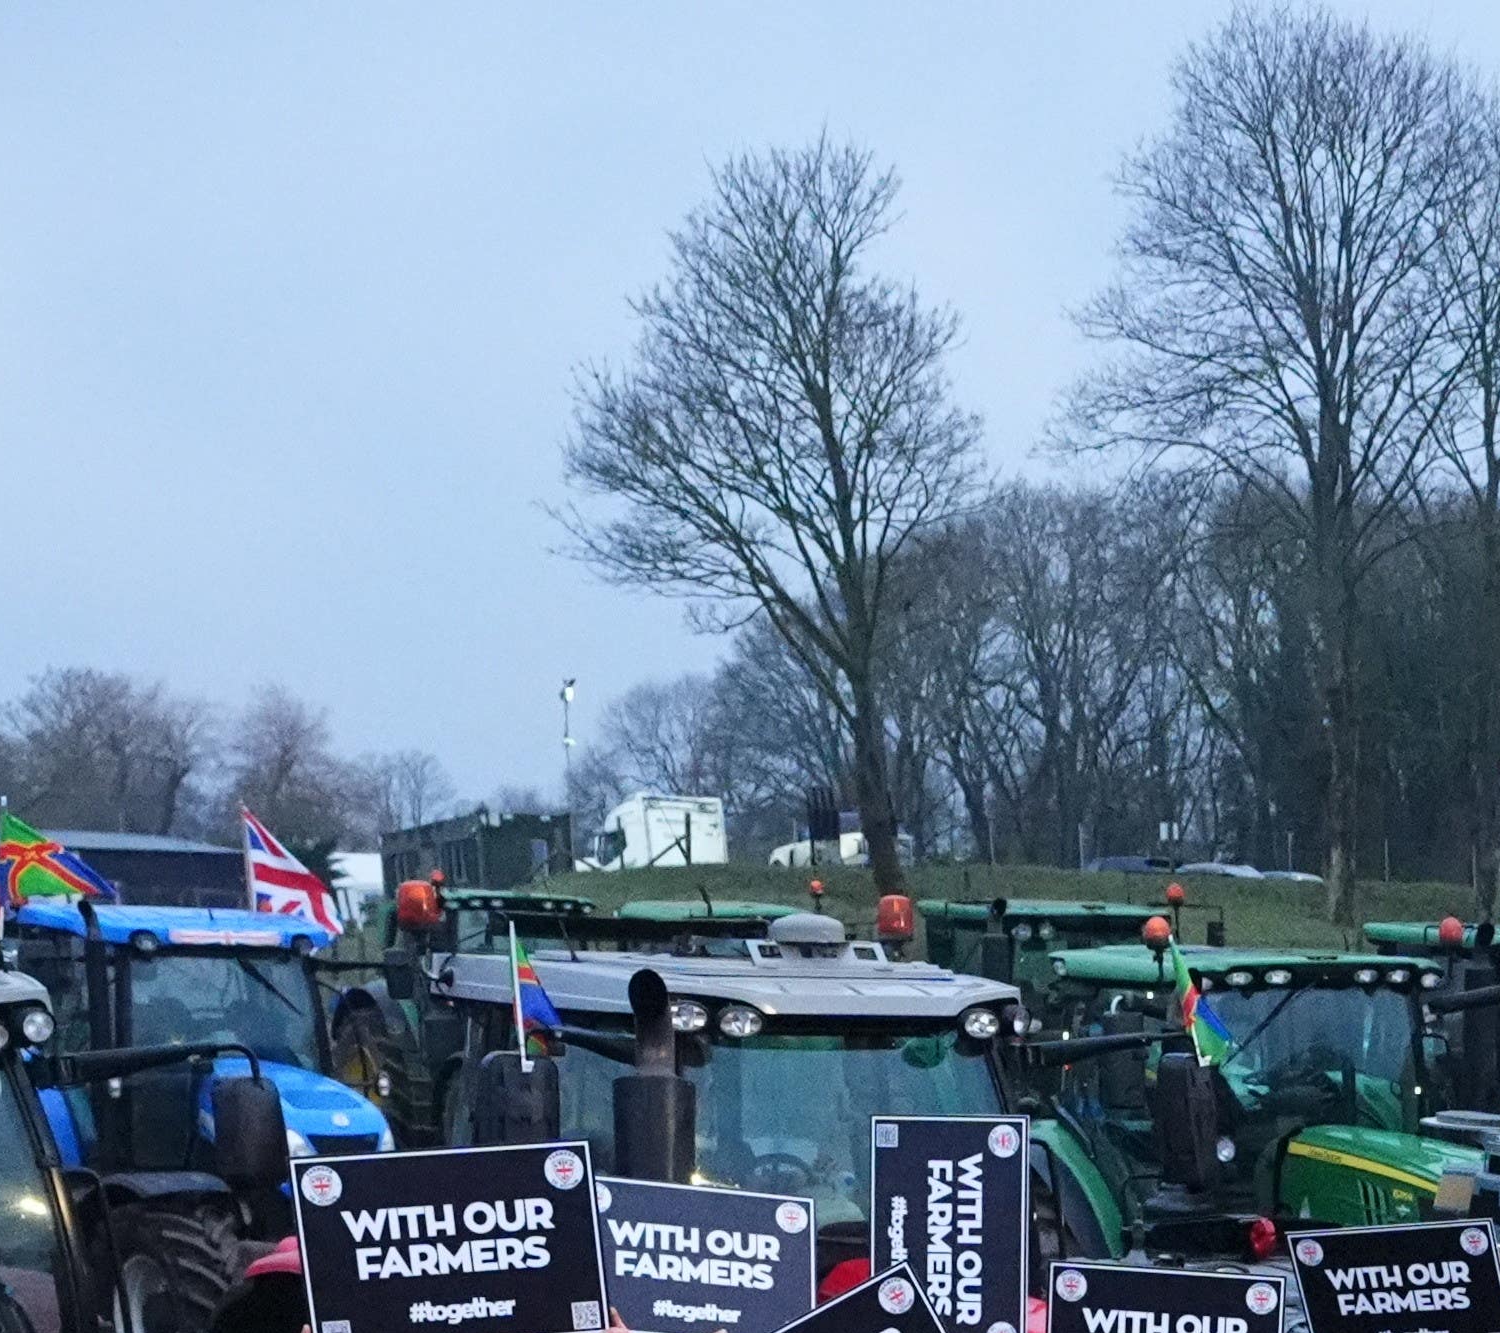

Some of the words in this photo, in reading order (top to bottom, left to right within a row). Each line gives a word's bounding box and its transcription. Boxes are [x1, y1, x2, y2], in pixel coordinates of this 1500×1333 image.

[957, 1153, 983, 1244] WITH
[340, 1204, 456, 1242] WITH
[463, 1198, 555, 1234] OUR
[607, 1219, 699, 1253] WITH
[706, 1230, 780, 1261] OUR
[356, 1236, 550, 1280] FARMERS
[616, 1250, 773, 1290] FARMERS
[1324, 1265, 1403, 1290] WITH
[1407, 1261, 1471, 1285] OUR
[956, 1251, 982, 1325] OUR
[1337, 1287, 1470, 1315] FARMERS
[410, 1297, 516, 1324] #together
[653, 1300, 741, 1323] #together
